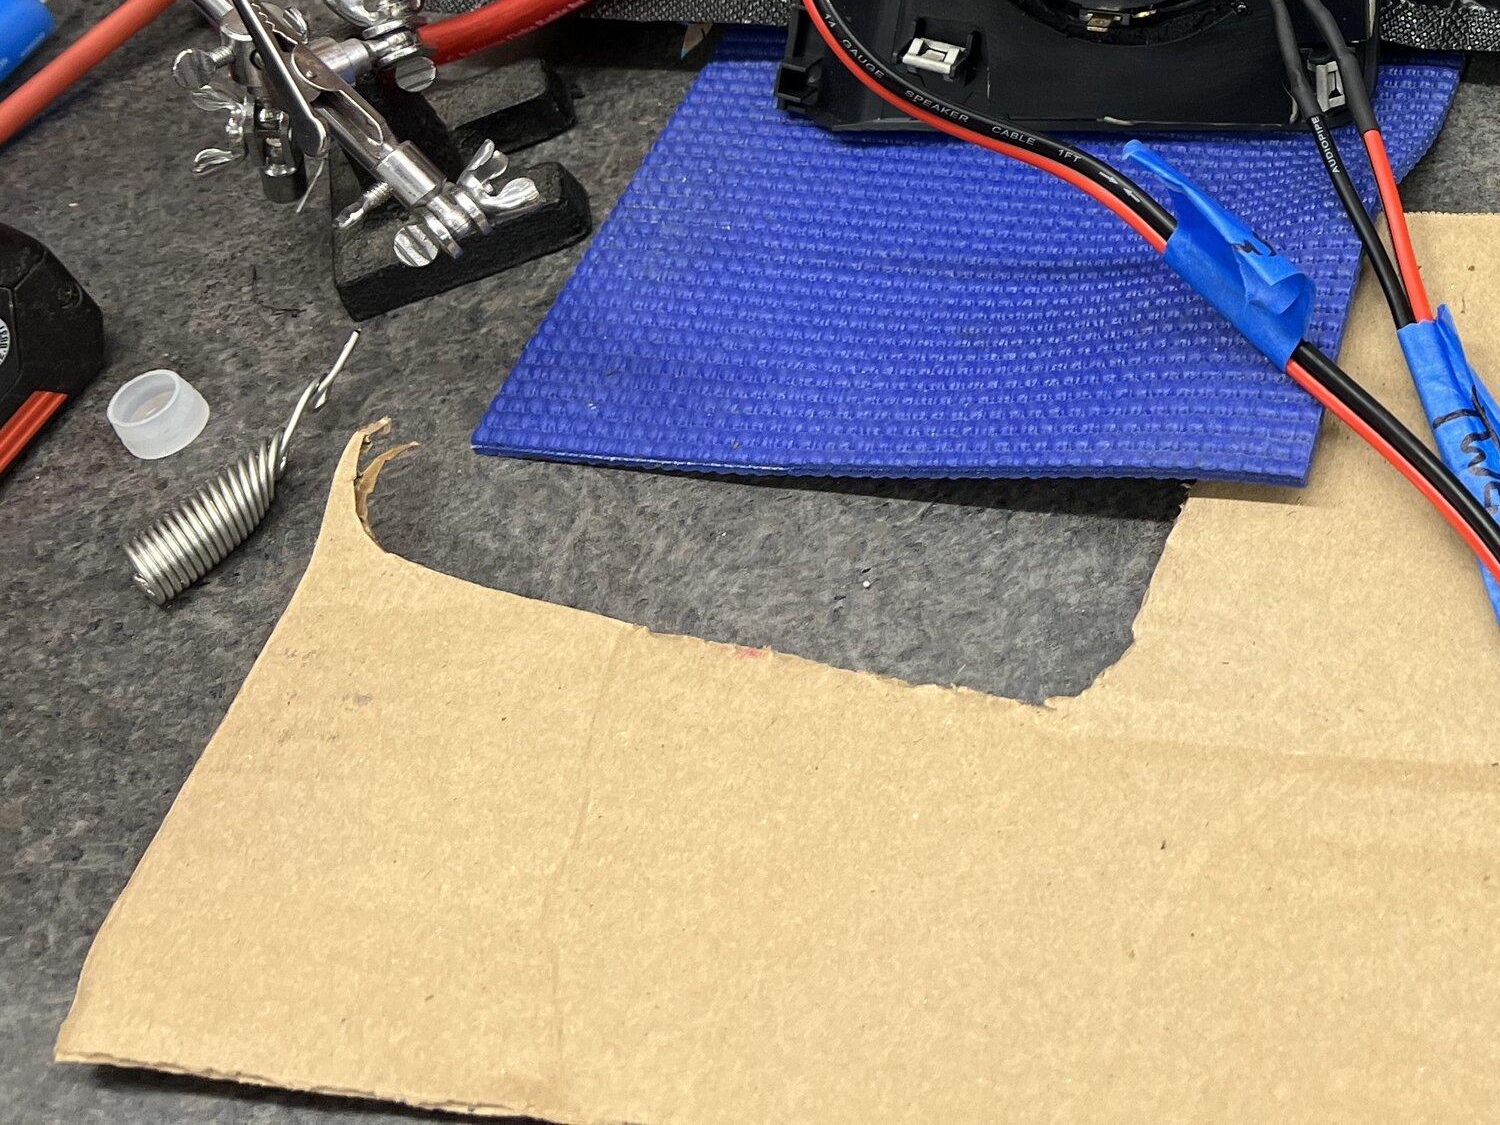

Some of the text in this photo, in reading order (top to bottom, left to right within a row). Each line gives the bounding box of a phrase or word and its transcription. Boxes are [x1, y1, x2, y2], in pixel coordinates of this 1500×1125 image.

[824, 13, 836, 28] 14
[842, 39, 885, 78] GAUGE
[904, 89, 969, 123] SPEAKER
[991, 125, 1036, 146] CABLE
[1057, 148, 1082, 163] 1FT
[1311, 115, 1340, 174] AUDIOPIPE
